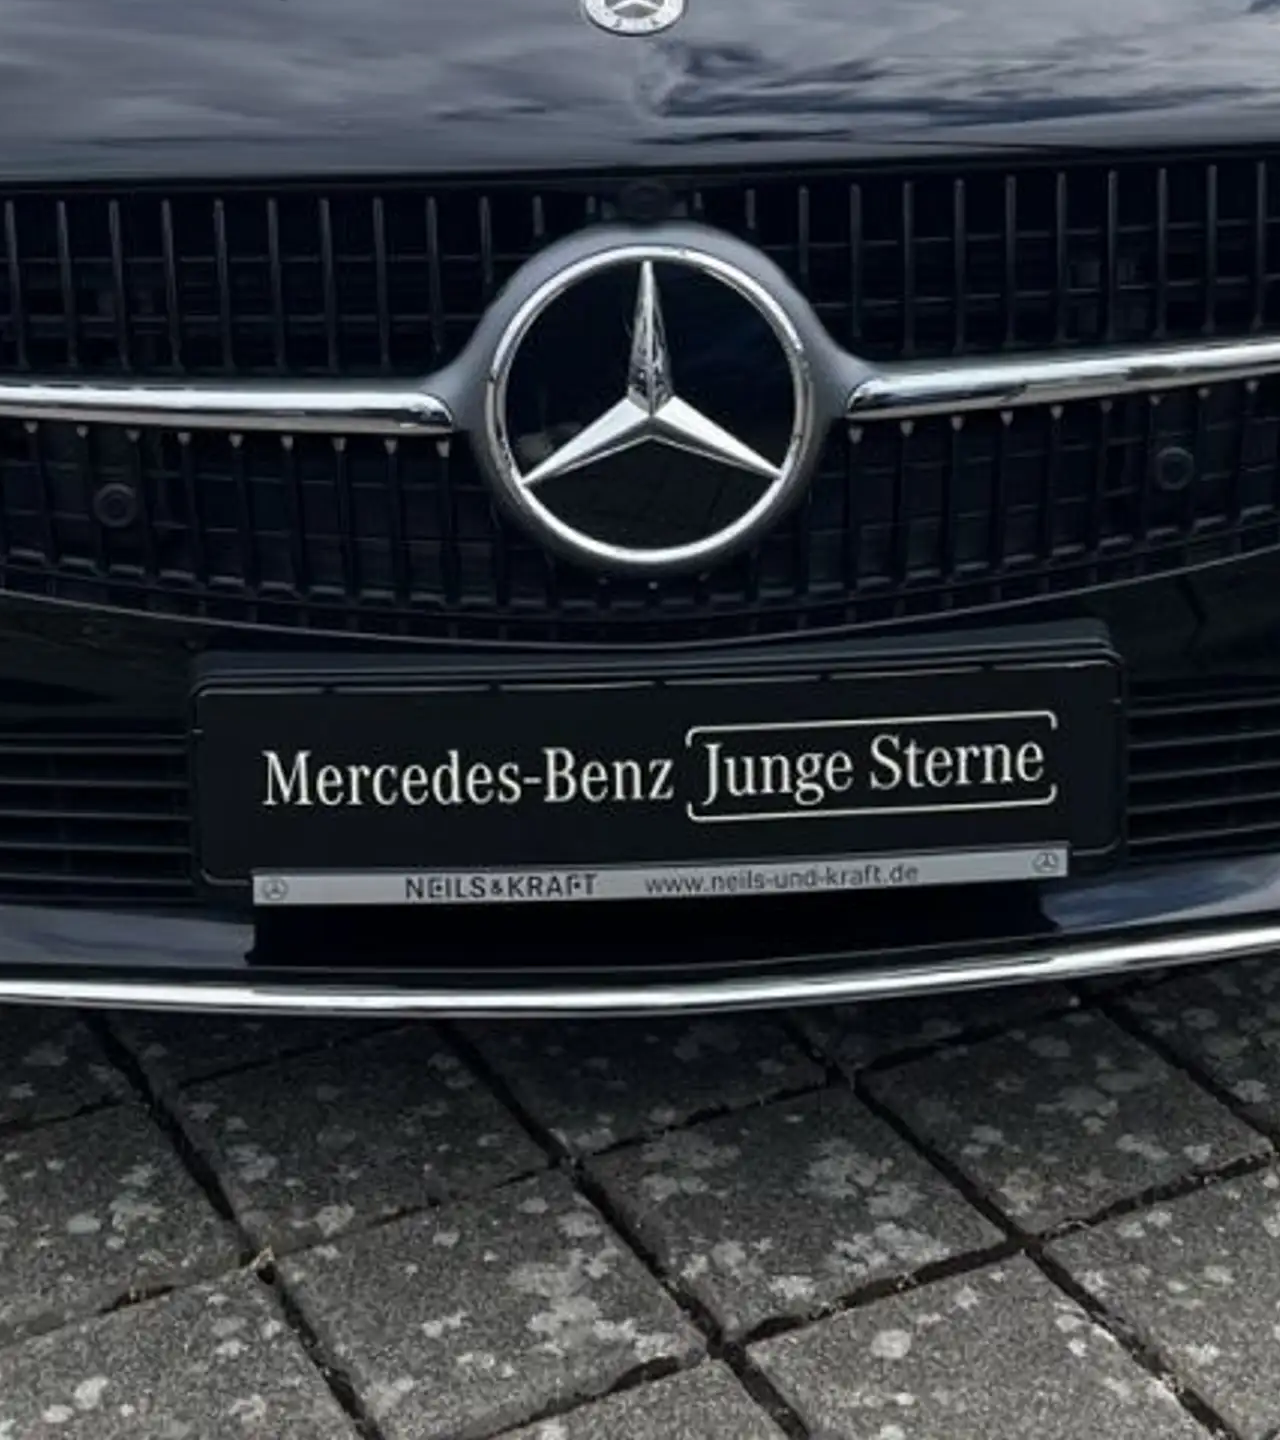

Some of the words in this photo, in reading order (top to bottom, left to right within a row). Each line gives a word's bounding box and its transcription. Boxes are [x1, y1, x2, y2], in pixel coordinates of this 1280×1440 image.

[260, 745, 676, 806] Mercedes-Benz
[701, 742, 855, 807] Junge
[868, 732, 1045, 791] Sterne
[404, 872, 598, 900] NEILS&KRAFT
[642, 862, 920, 895] www.neils-und-kraft.de
